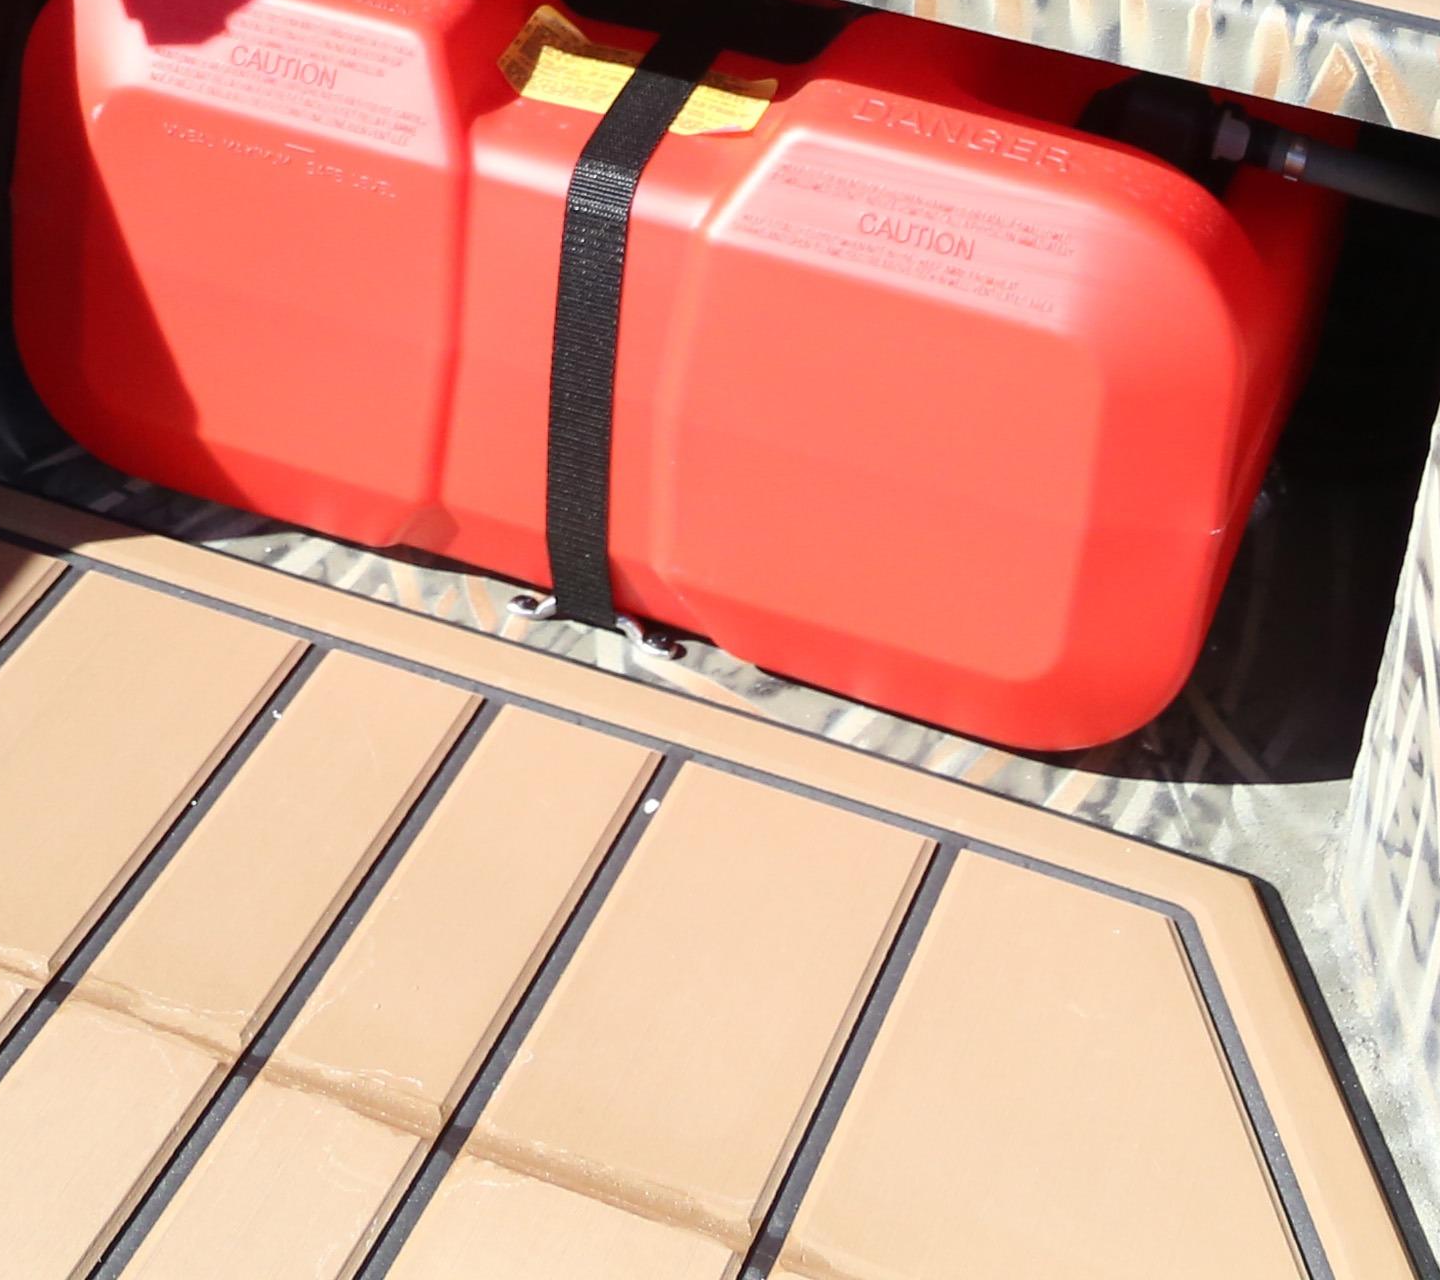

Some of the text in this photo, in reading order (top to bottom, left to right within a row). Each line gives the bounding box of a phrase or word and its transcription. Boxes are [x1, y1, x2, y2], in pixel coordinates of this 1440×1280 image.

[229, 44, 339, 91] CAUTION
[851, 98, 1073, 173] DANGER
[857, 211, 976, 262] CAUTION
